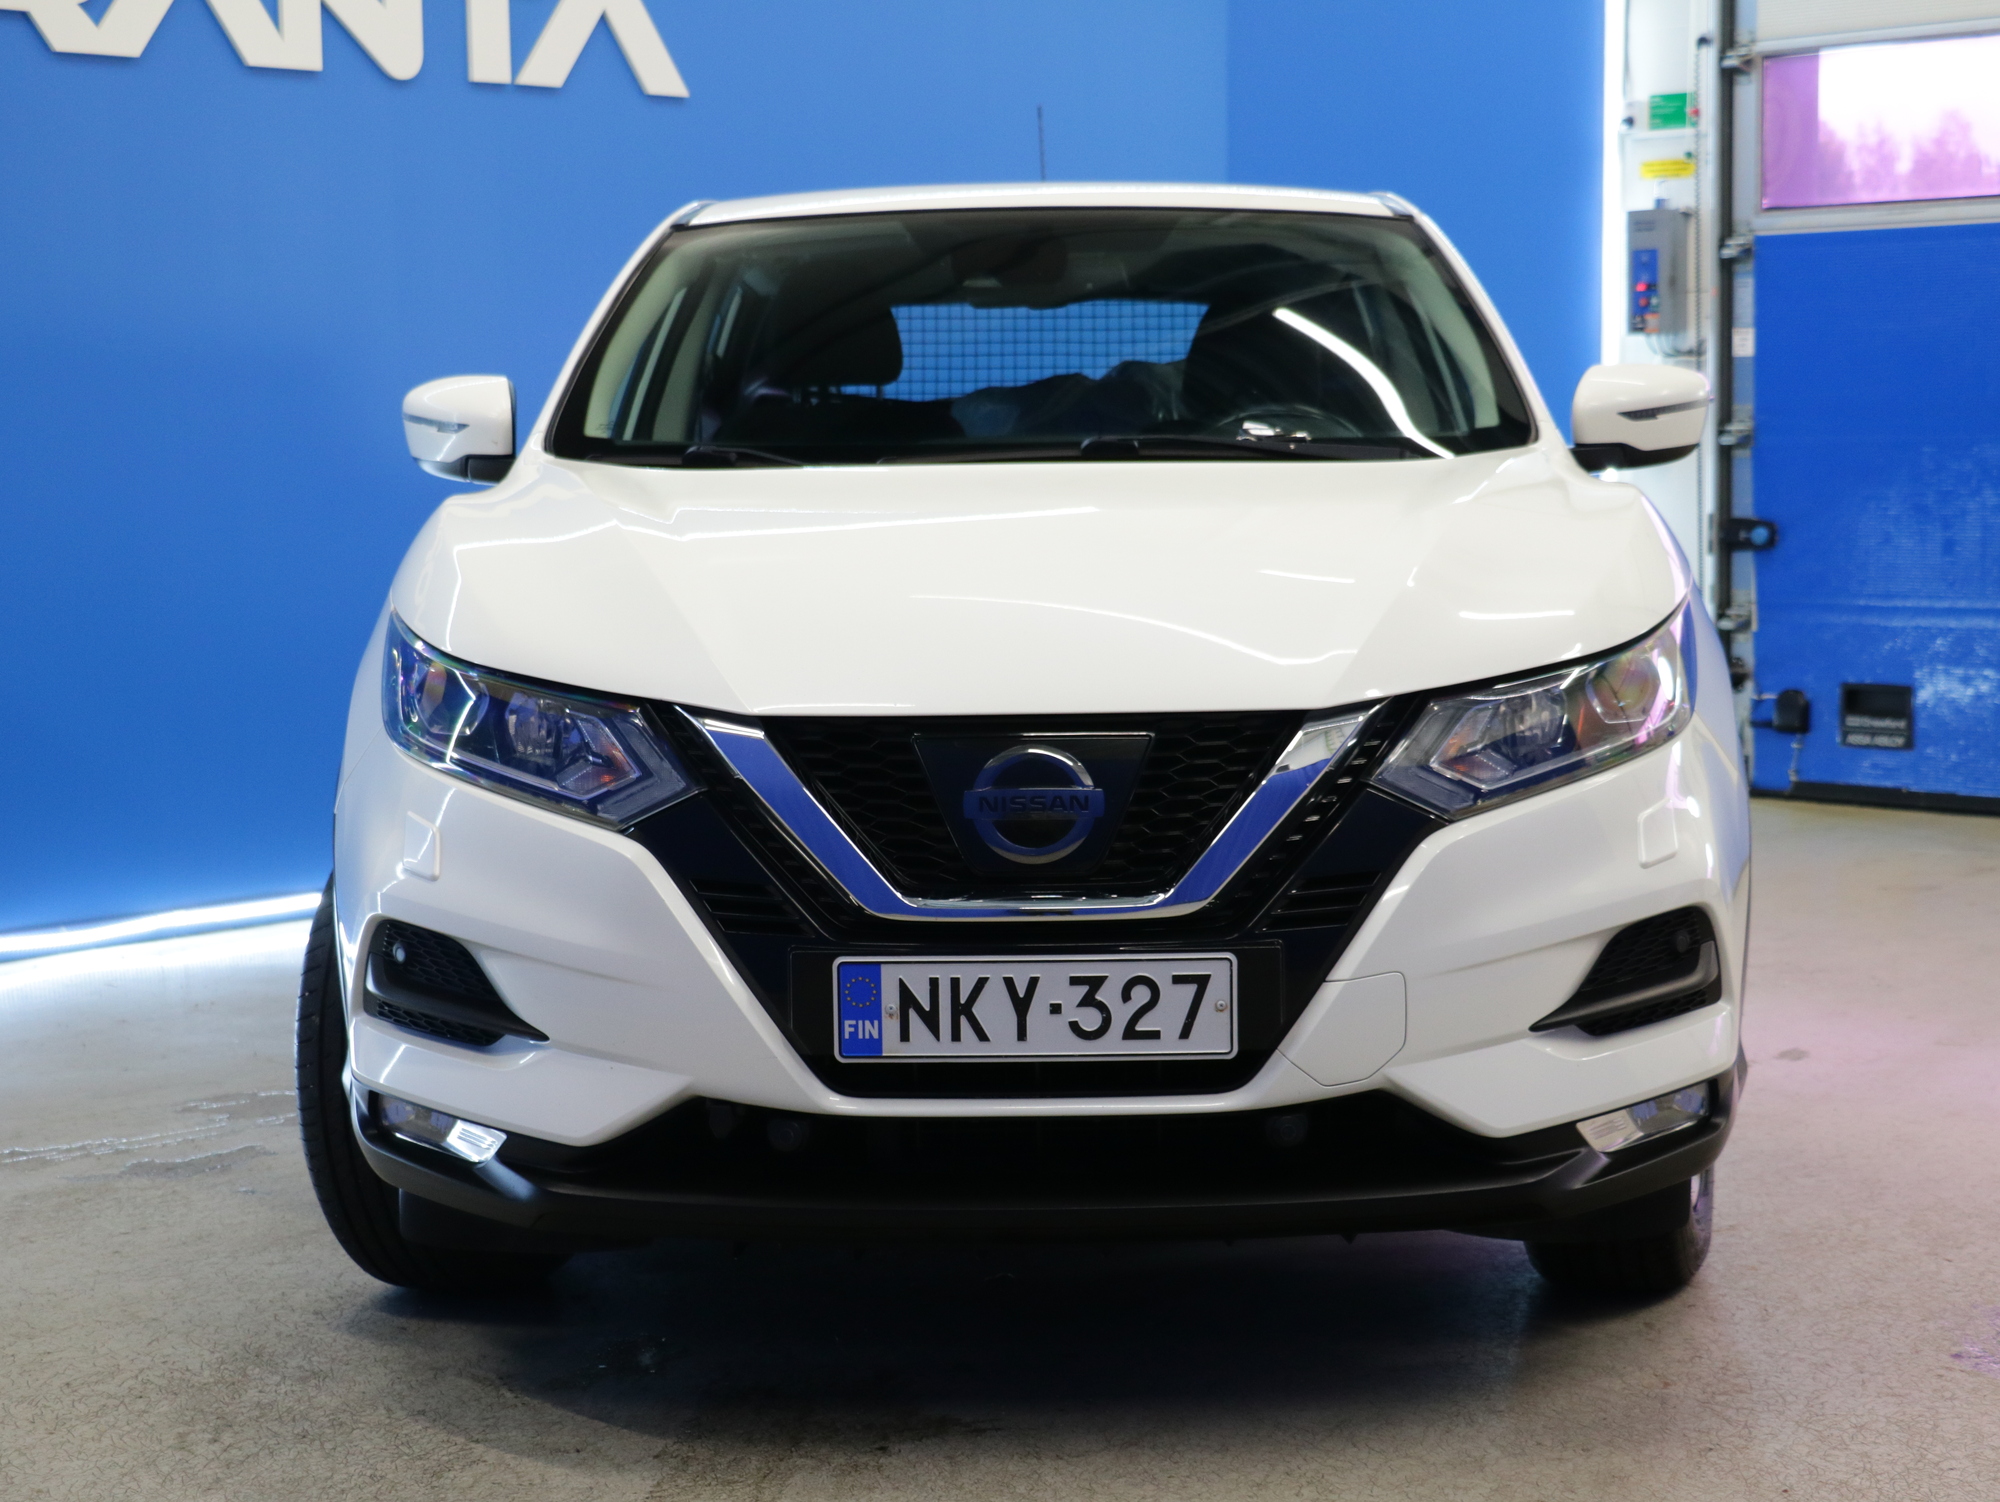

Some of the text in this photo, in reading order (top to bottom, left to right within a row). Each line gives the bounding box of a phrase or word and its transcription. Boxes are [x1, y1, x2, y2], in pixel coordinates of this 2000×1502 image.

[979, 795, 1090, 813] NISSAN
[899, 973, 1212, 1043] NKY-327
[844, 1020, 879, 1040] FIN
